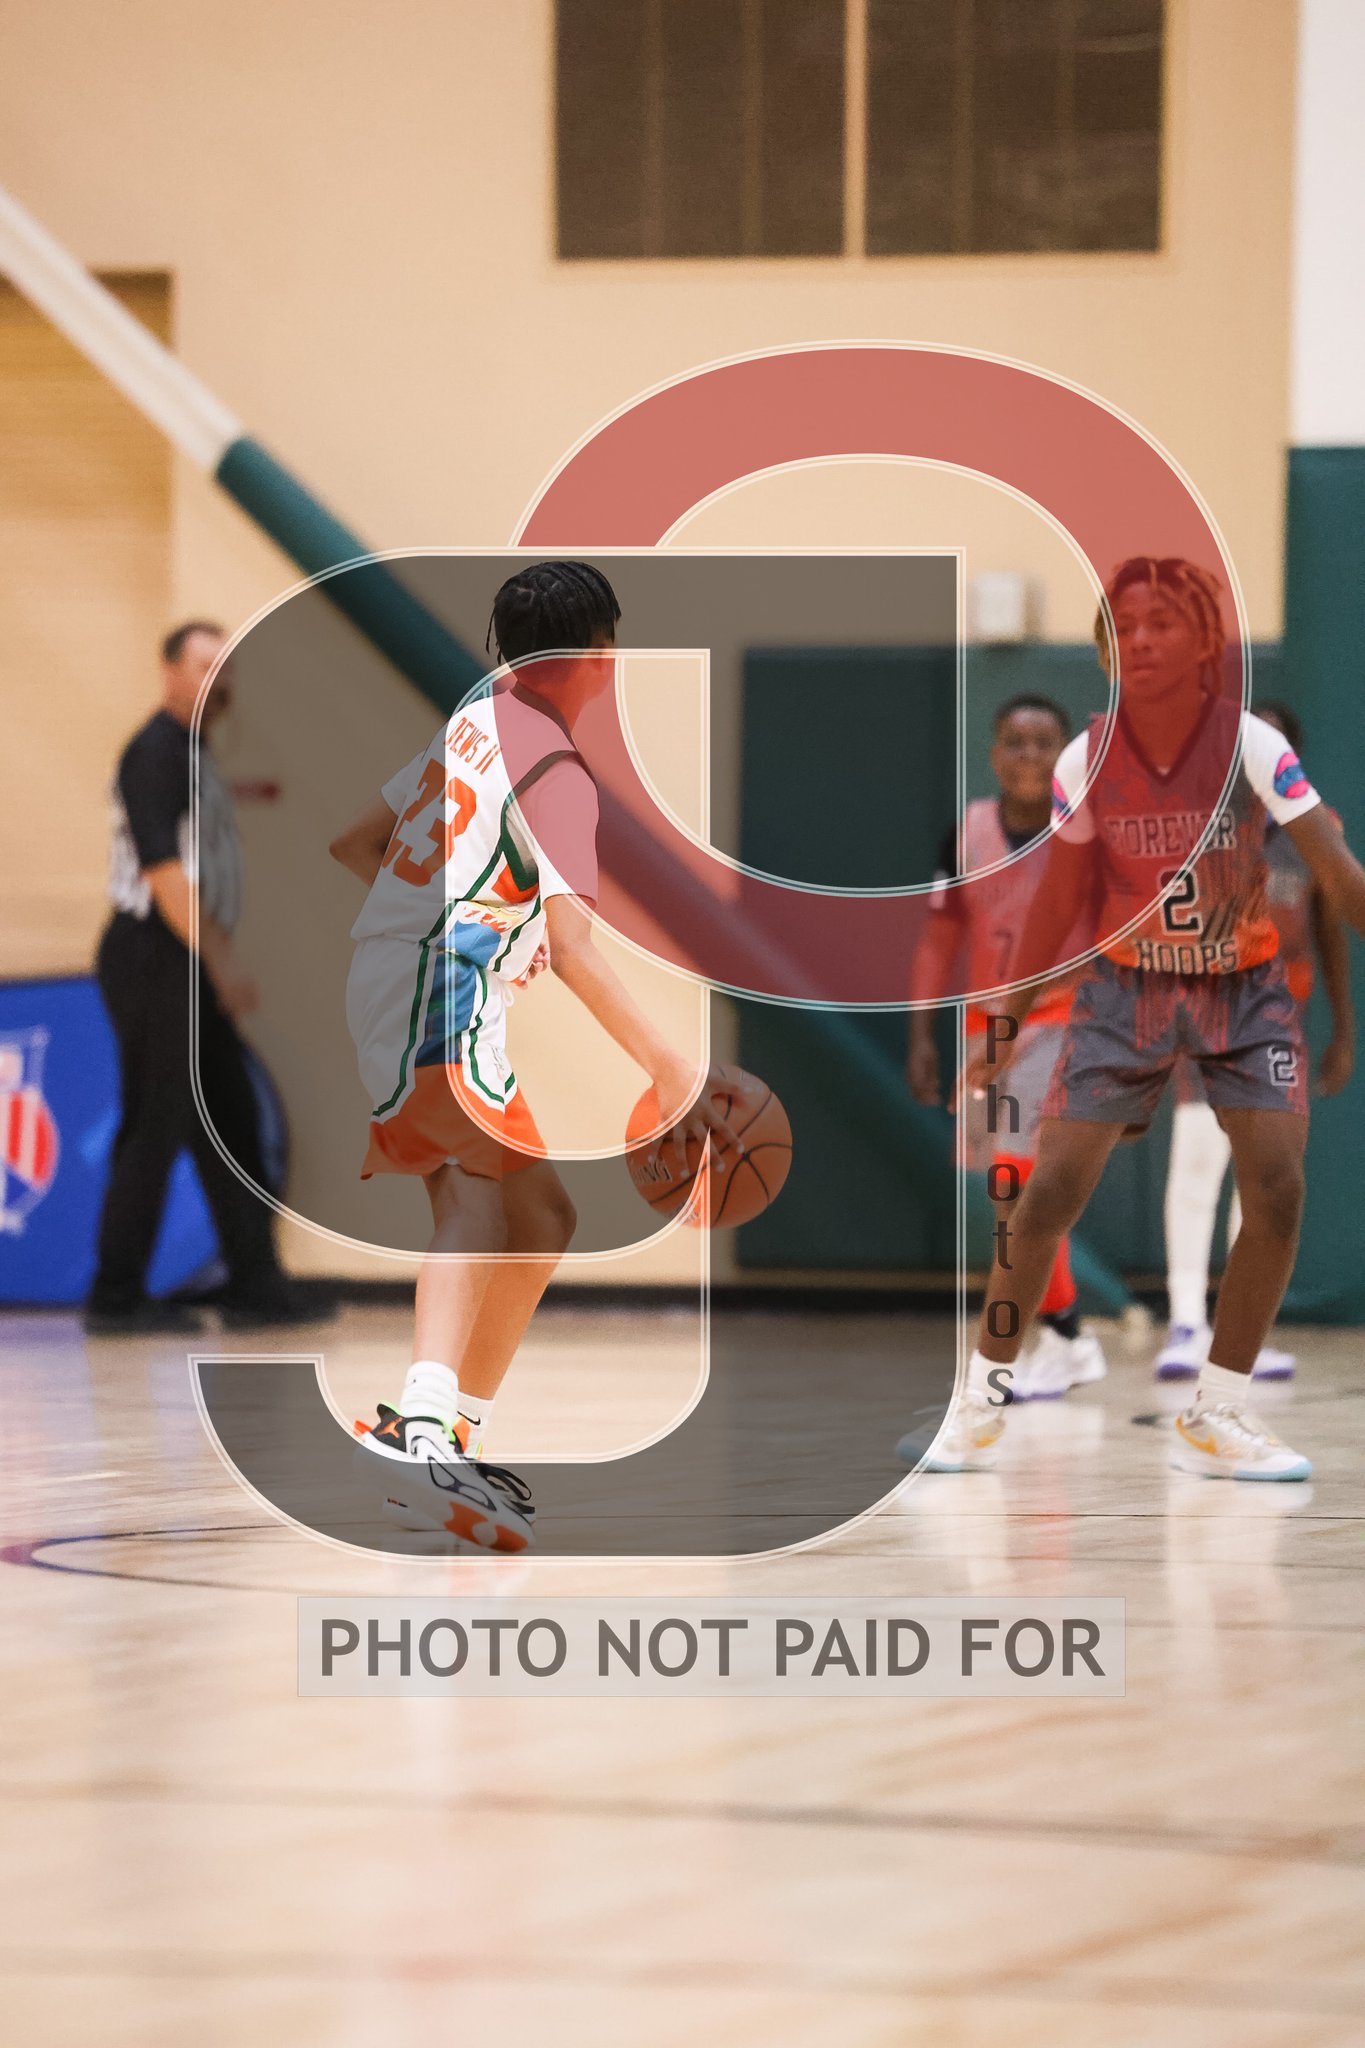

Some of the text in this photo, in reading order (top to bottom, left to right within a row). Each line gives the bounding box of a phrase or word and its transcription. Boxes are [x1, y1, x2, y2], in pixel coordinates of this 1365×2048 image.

[1157, 867, 1203, 936] 2
[1135, 937, 1240, 974] HOOPS
[1267, 1044, 1298, 1087] 2
